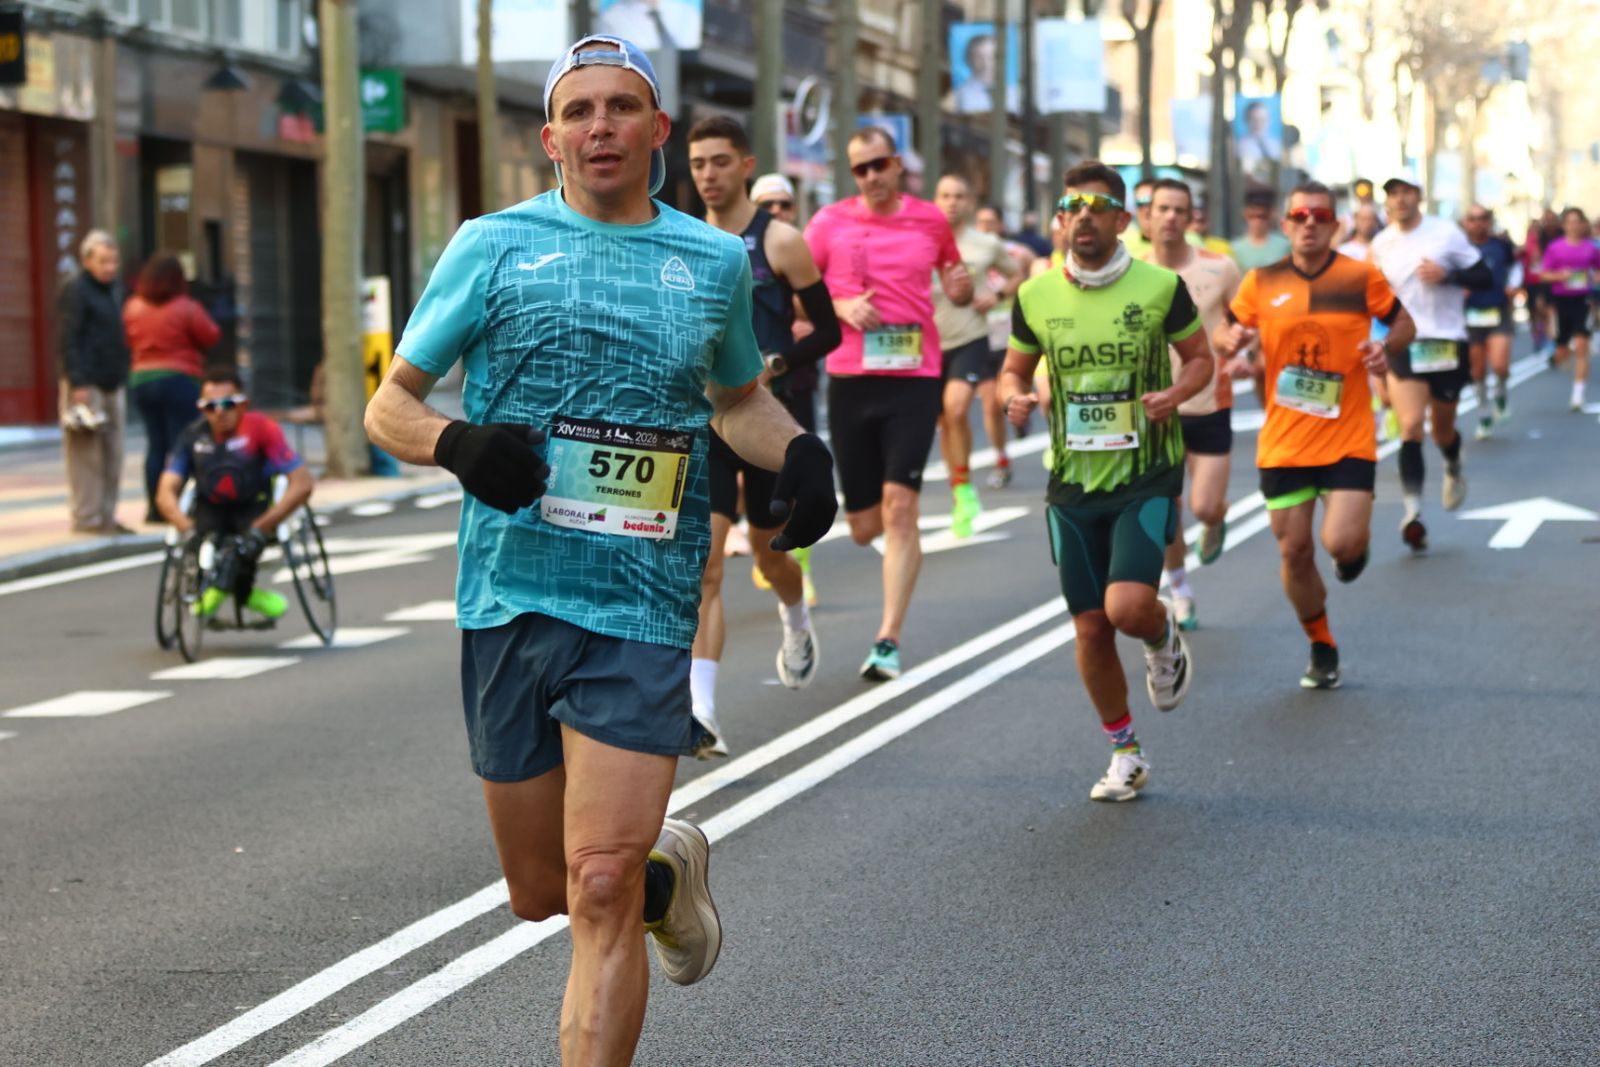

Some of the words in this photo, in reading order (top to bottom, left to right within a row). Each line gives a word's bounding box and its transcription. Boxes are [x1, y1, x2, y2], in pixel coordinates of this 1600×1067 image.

[1295, 378, 1326, 394] 623
[1079, 406, 1117, 423] 606
[557, 424, 577, 436] XIV
[575, 425, 600, 435] MEDIA
[635, 432, 658, 444] 2026
[588, 450, 655, 483] 570
[596, 486, 642, 498] TERRONES
[548, 506, 586, 519] LABORAL
[623, 519, 664, 533] bedunia
